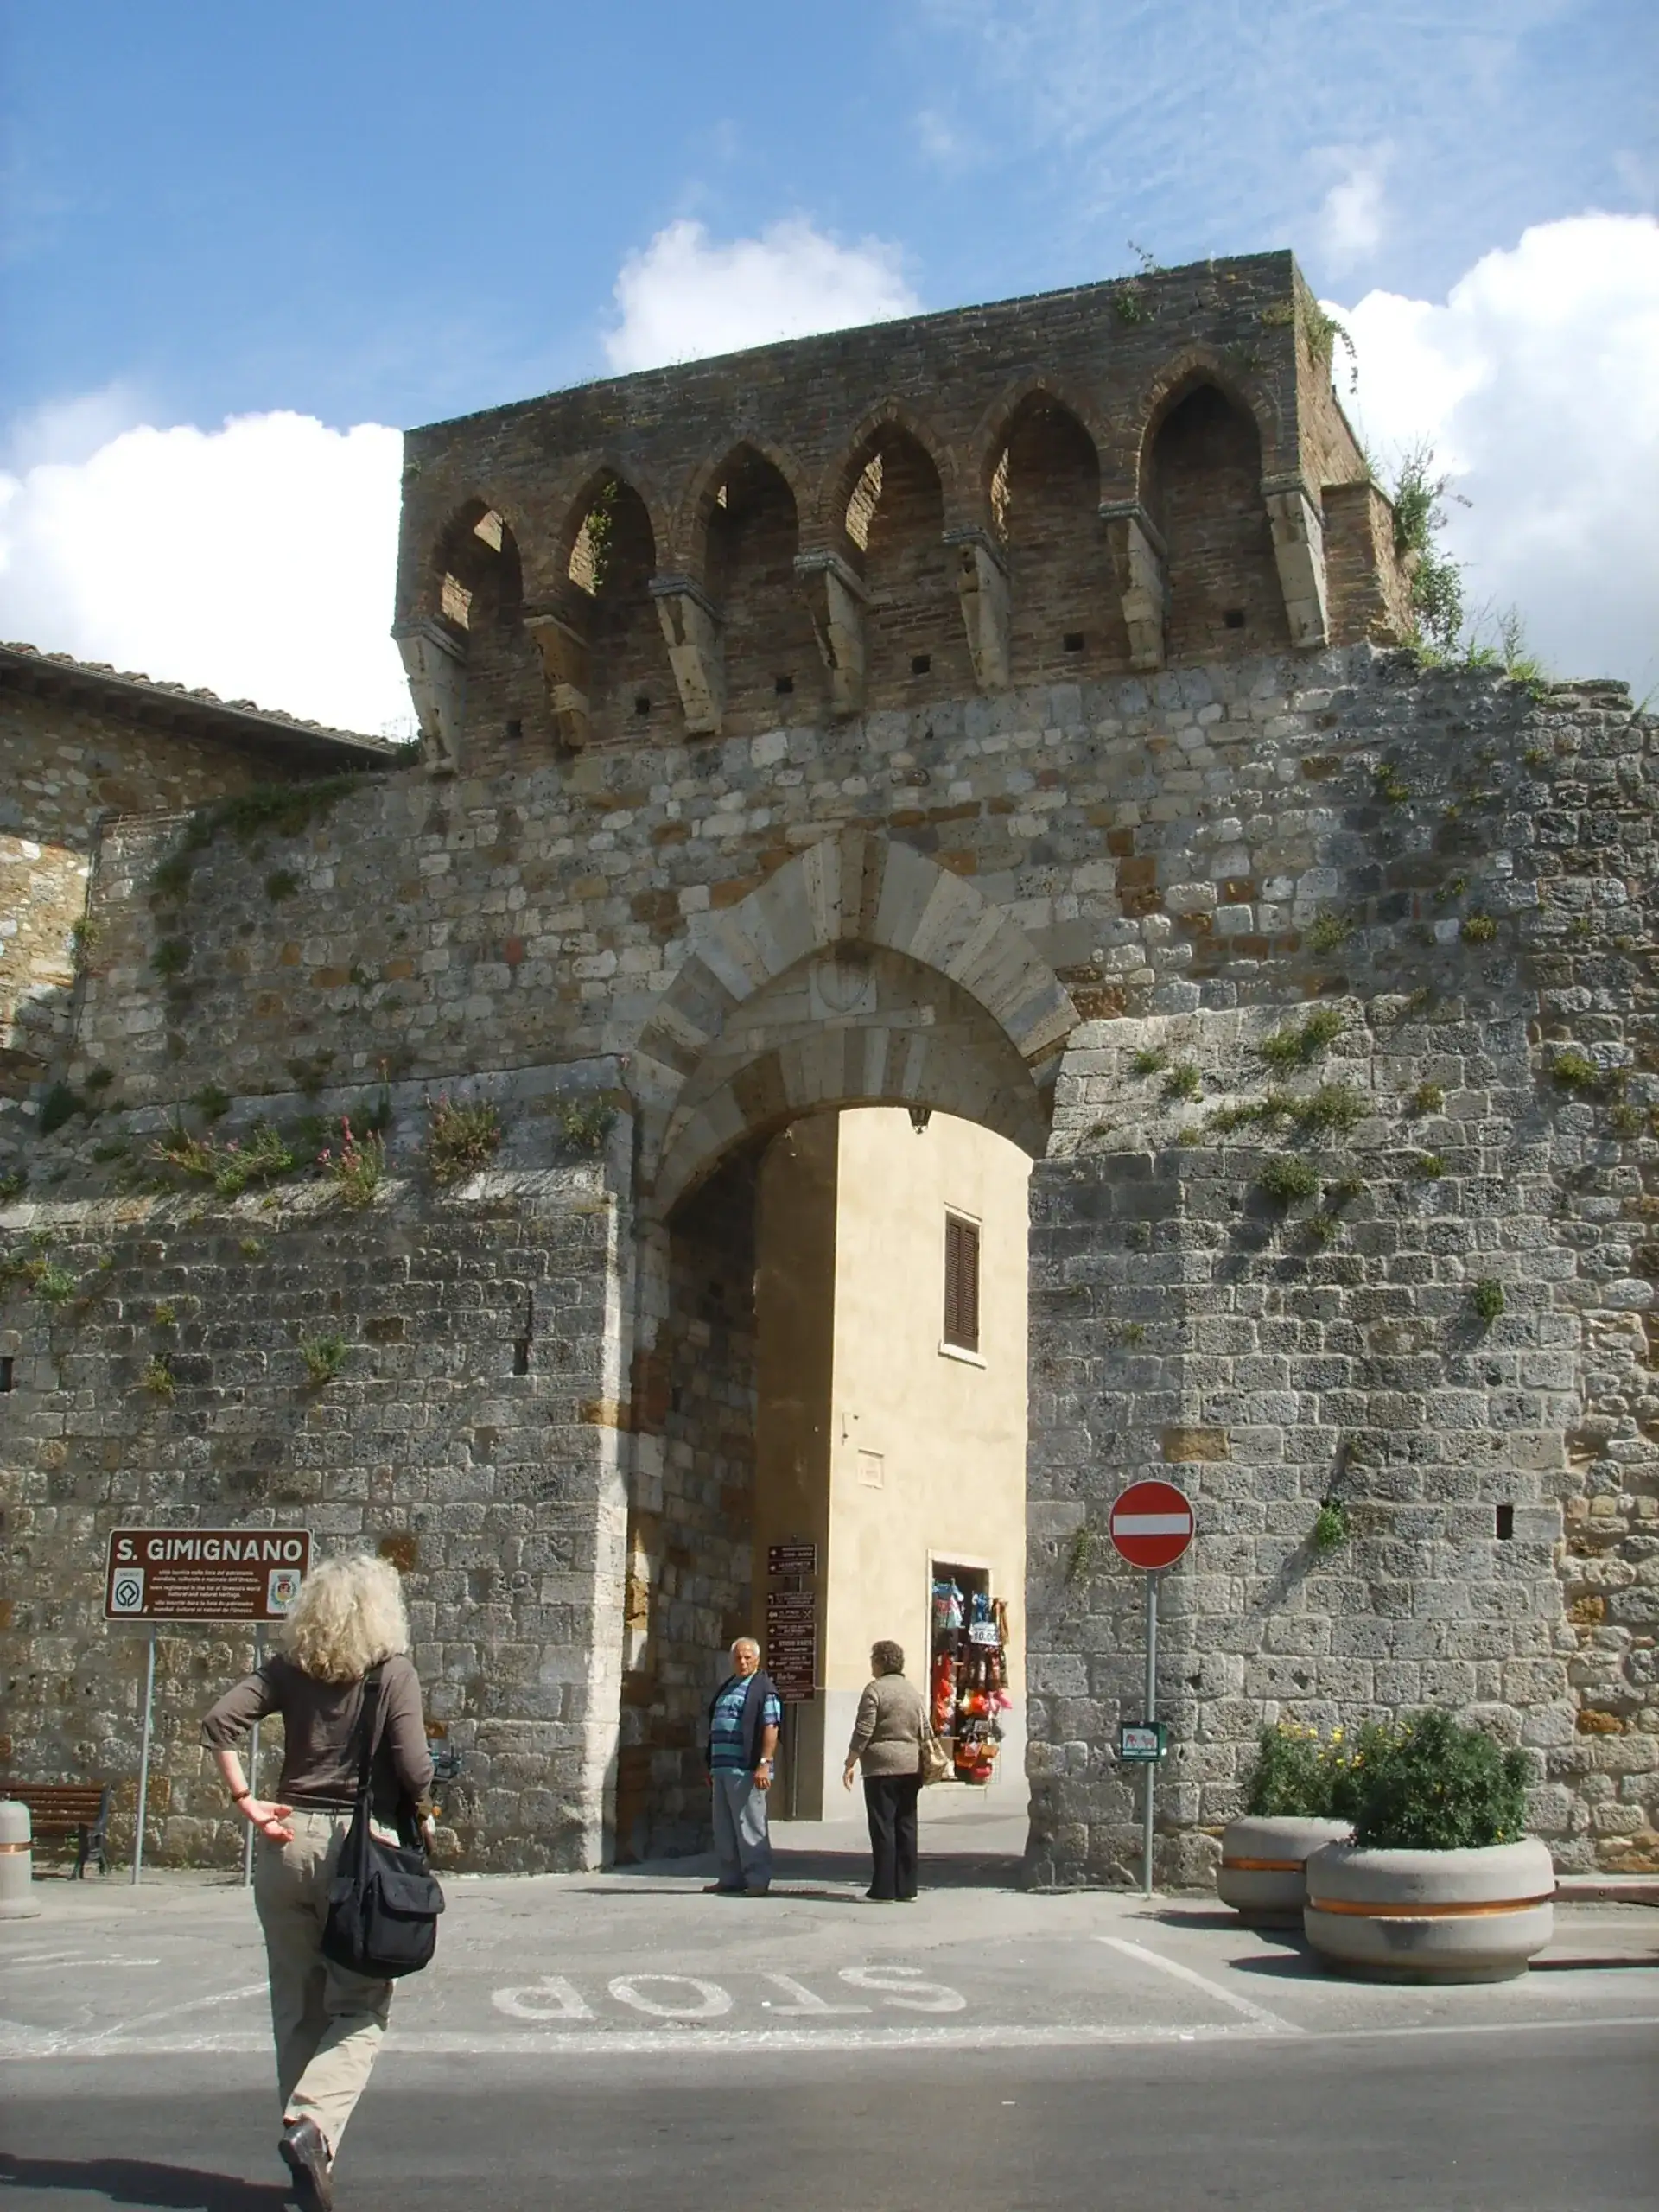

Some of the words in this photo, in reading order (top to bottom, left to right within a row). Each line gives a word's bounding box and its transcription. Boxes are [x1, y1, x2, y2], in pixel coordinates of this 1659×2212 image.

[117, 1539, 138, 1560] S.
[146, 1539, 302, 1561] GIMIGNANO
[492, 1965, 967, 2020] STOP
